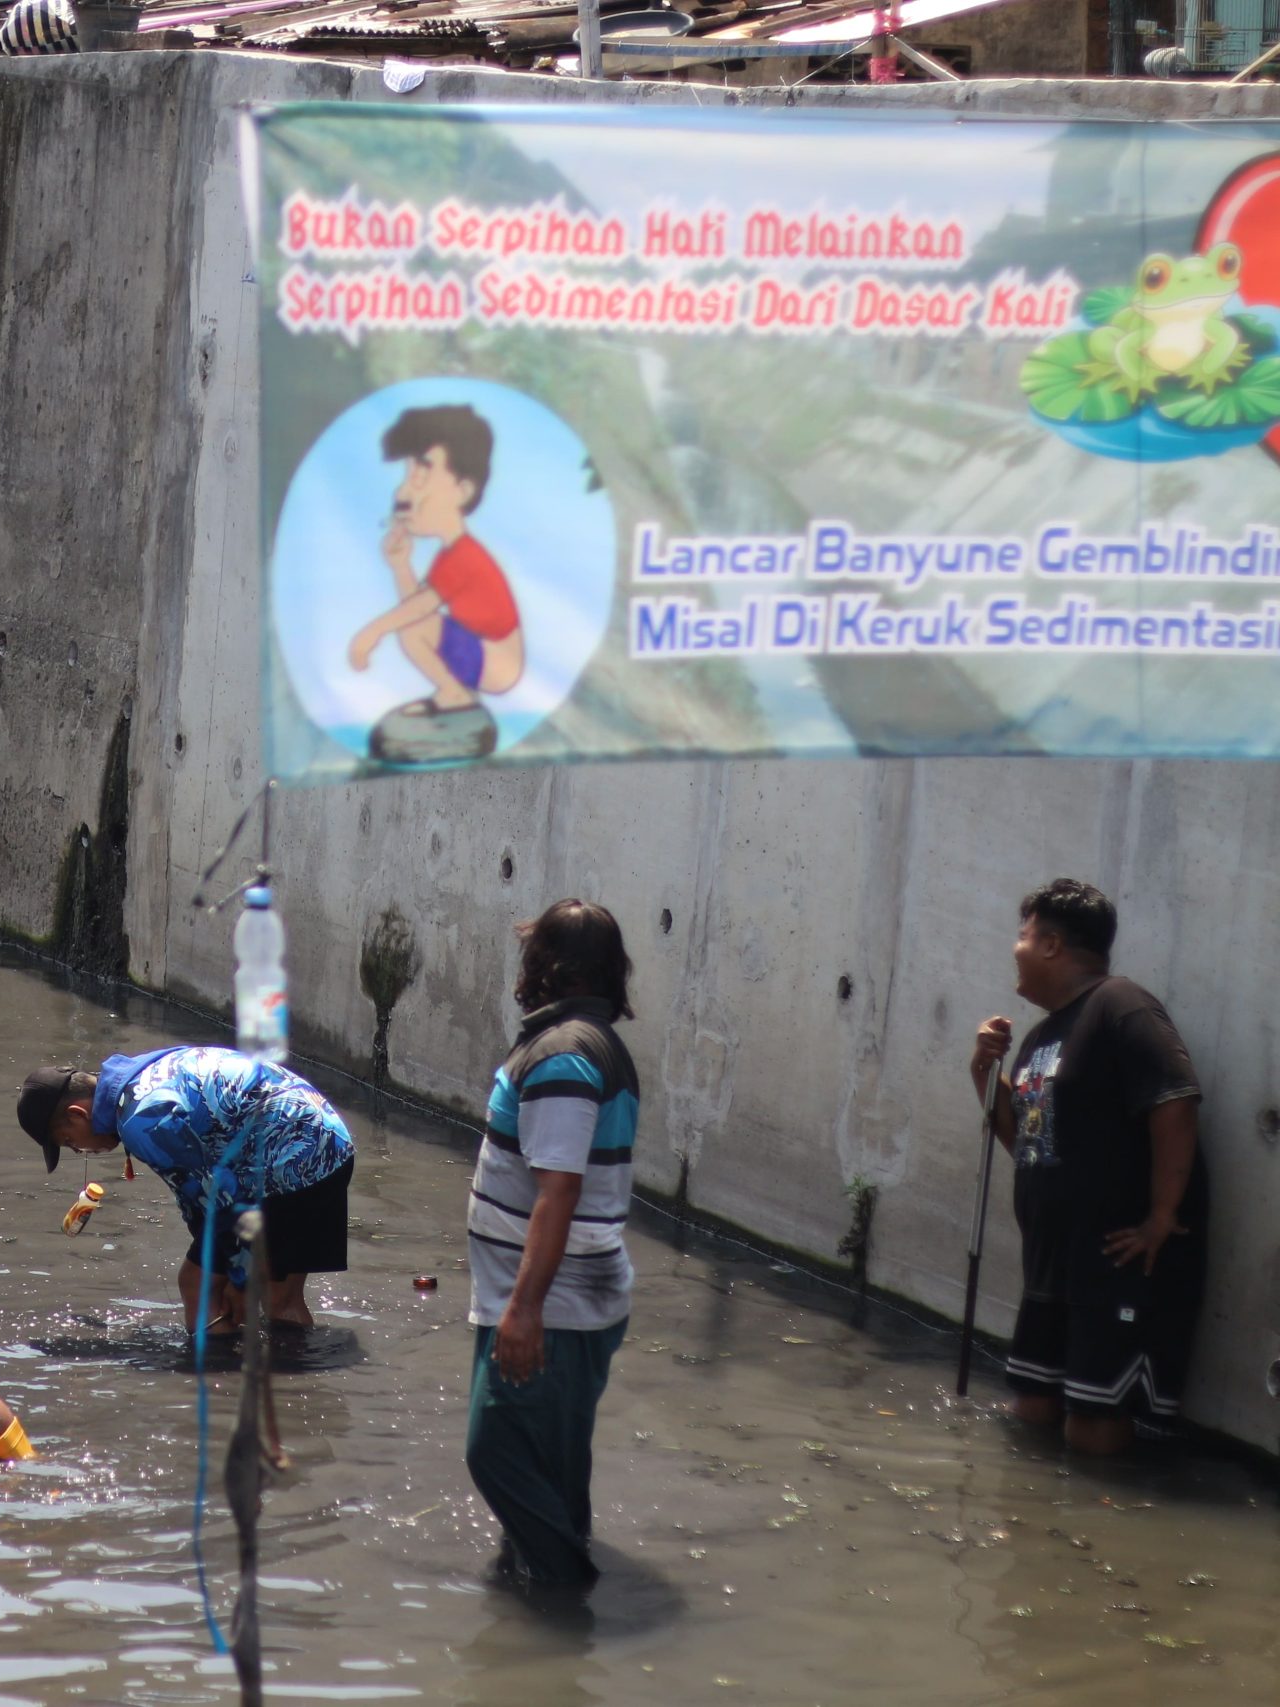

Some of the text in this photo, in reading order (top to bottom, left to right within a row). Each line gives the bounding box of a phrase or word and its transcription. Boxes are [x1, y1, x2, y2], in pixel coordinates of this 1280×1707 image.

[287, 201, 964, 259] Bukan Serpihan Hati Melainkan
[286, 271, 1072, 329] Serpihan Sedimentasi Dari Dasar Kali
[640, 526, 1280, 586] Lancar Banyune Gemblindi
[637, 599, 1280, 651] Misal Di Keruk Sedimentasi
